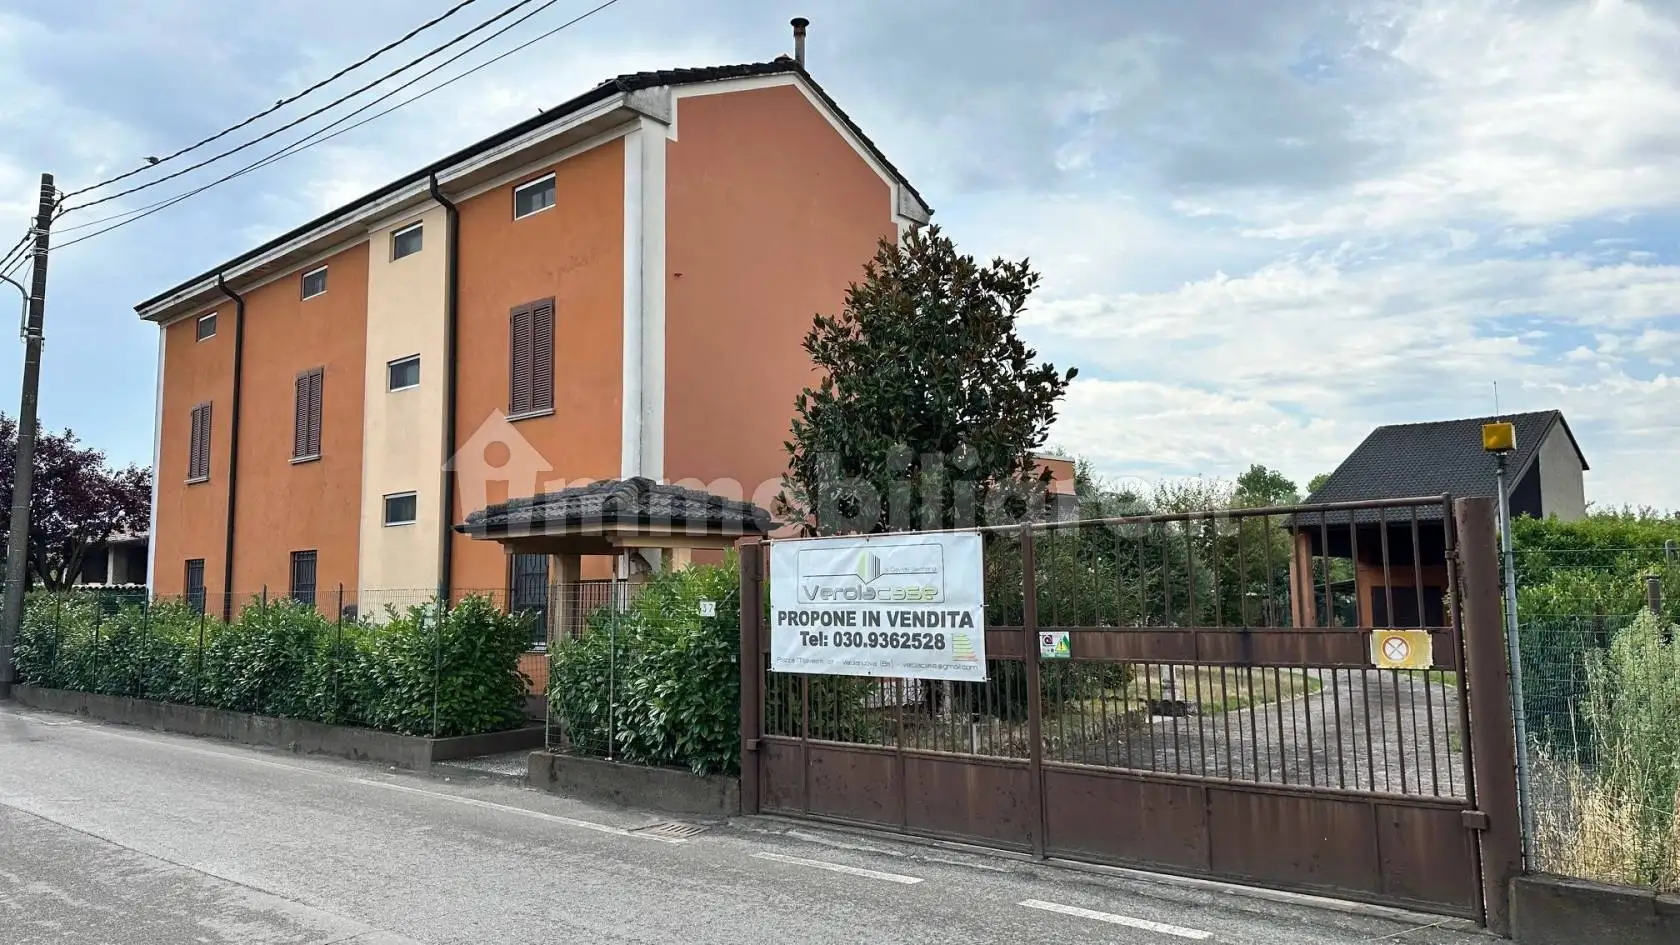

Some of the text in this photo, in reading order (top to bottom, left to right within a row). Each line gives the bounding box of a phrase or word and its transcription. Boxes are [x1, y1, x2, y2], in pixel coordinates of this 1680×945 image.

[777, 610, 974, 628] PROPONE IN VENDITA
[799, 631, 946, 650] Tel: 030.9362528
